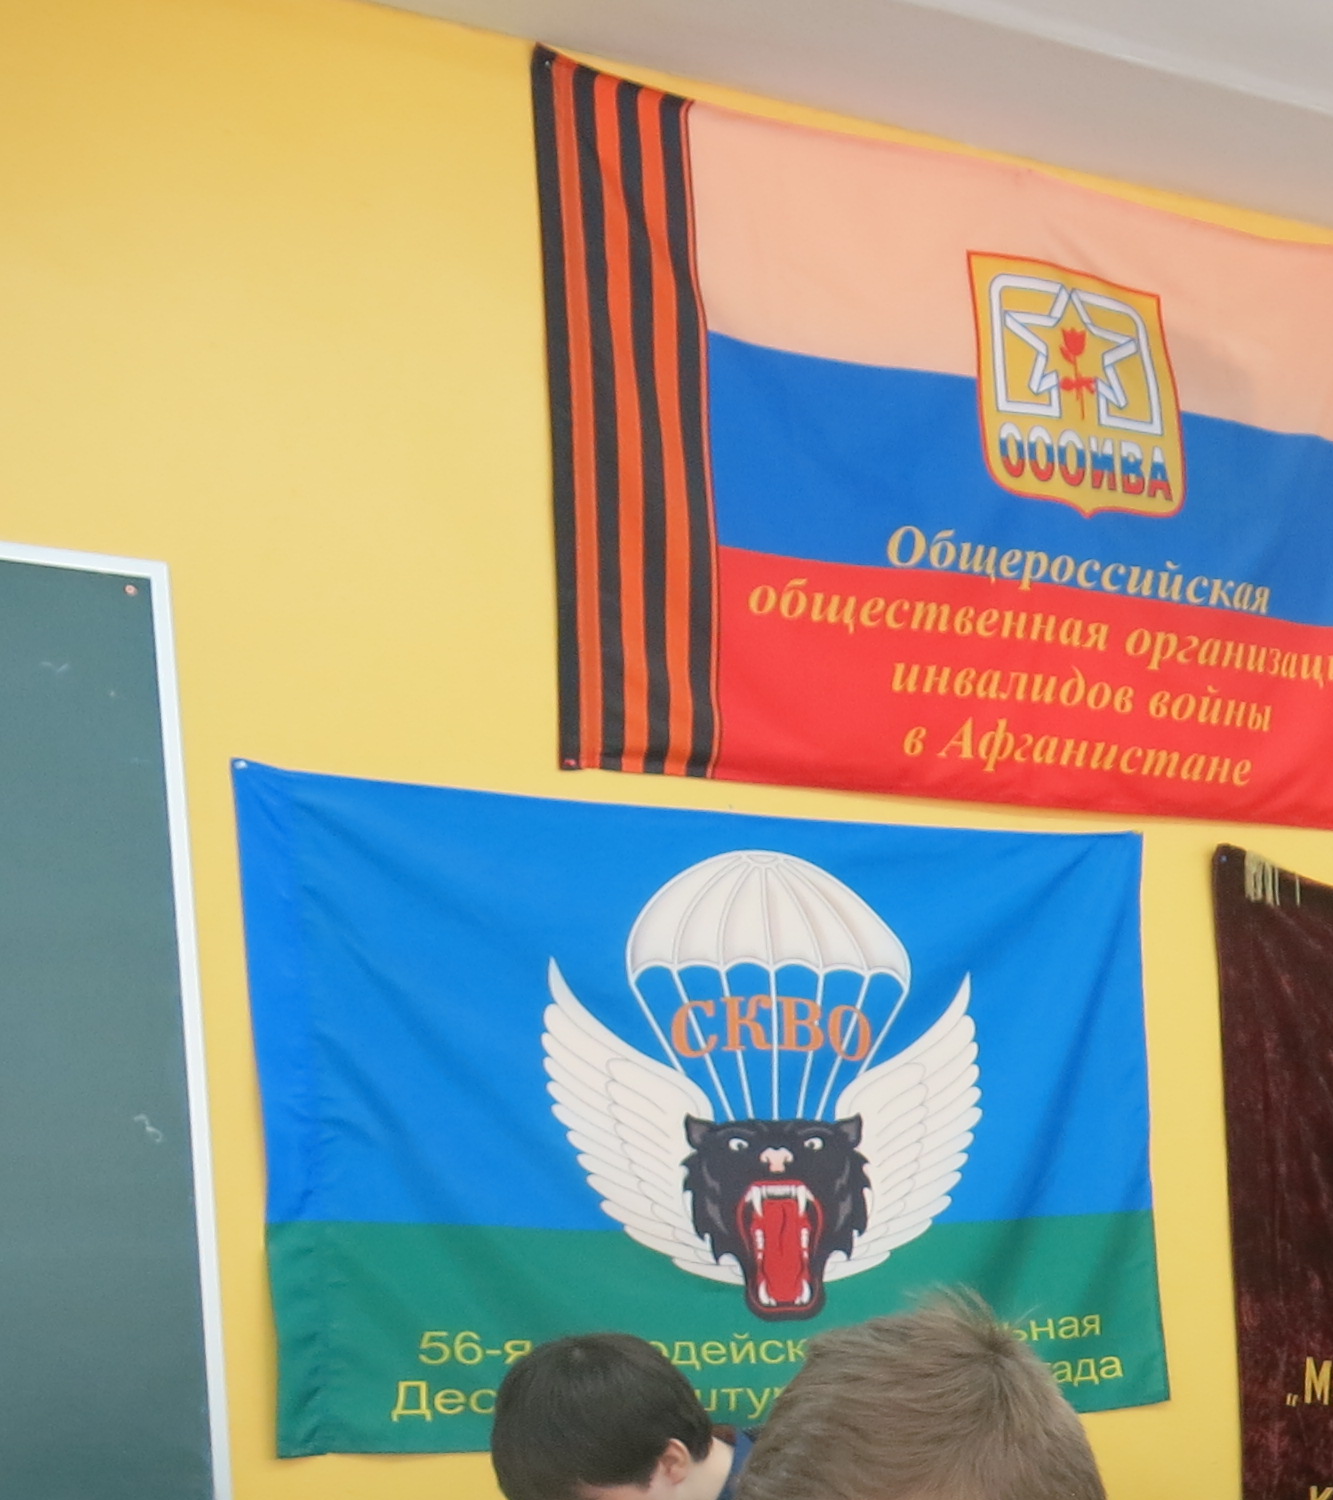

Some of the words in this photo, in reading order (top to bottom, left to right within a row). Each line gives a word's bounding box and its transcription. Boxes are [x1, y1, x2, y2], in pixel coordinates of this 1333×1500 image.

[999, 421, 1174, 502] ОООИВА
[886, 524, 1271, 616] Общероссийская
[748, 576, 1111, 653] общественная
[890, 661, 1134, 715] инвалидов
[1148, 683, 1273, 734] войны
[902, 726, 926, 758] в
[939, 718, 1254, 788] Афганистане
[670, 994, 872, 1063] СКВО
[418, 1330, 534, 1366] 56-я
